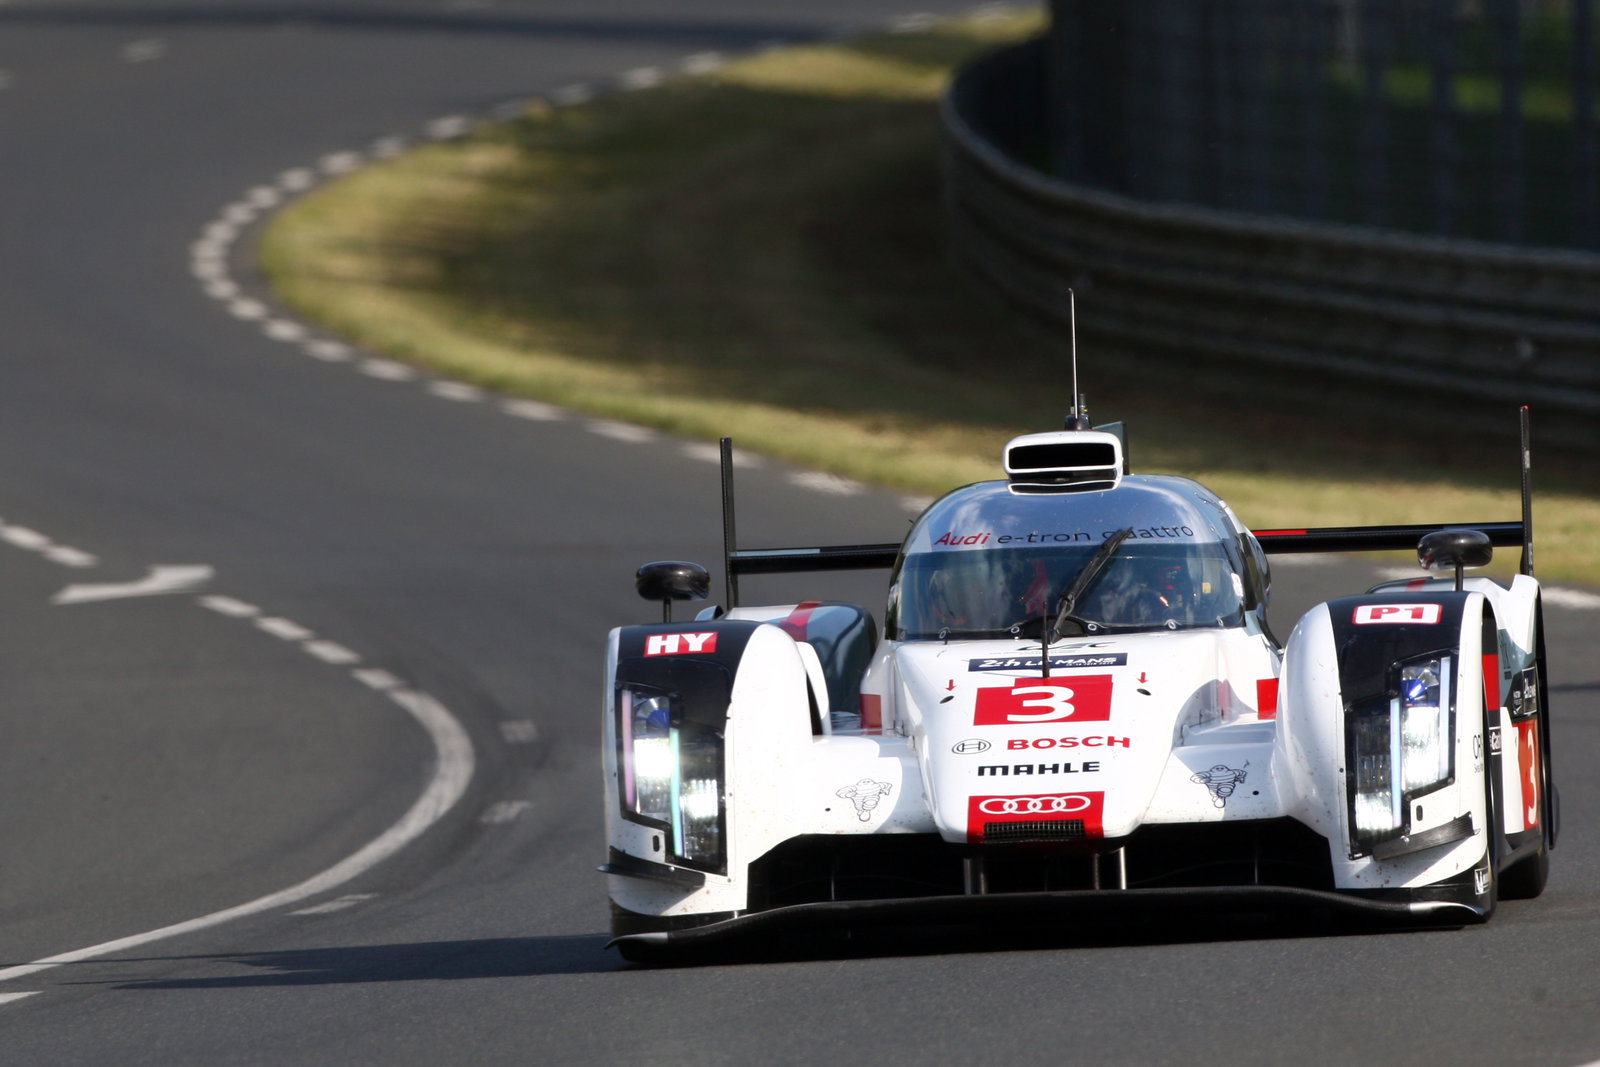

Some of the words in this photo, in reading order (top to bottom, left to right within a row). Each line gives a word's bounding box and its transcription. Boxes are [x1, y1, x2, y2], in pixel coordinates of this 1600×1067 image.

[934, 532, 991, 546] Audi
[997, 531, 1091, 545] e-tron
[1370, 606, 1424, 620] P1
[647, 632, 715, 655] HY
[1055, 657, 1117, 665] MANS
[1007, 685, 1076, 722] 3
[1007, 736, 1131, 750] BOSCH
[977, 761, 1101, 776] MAHLE
